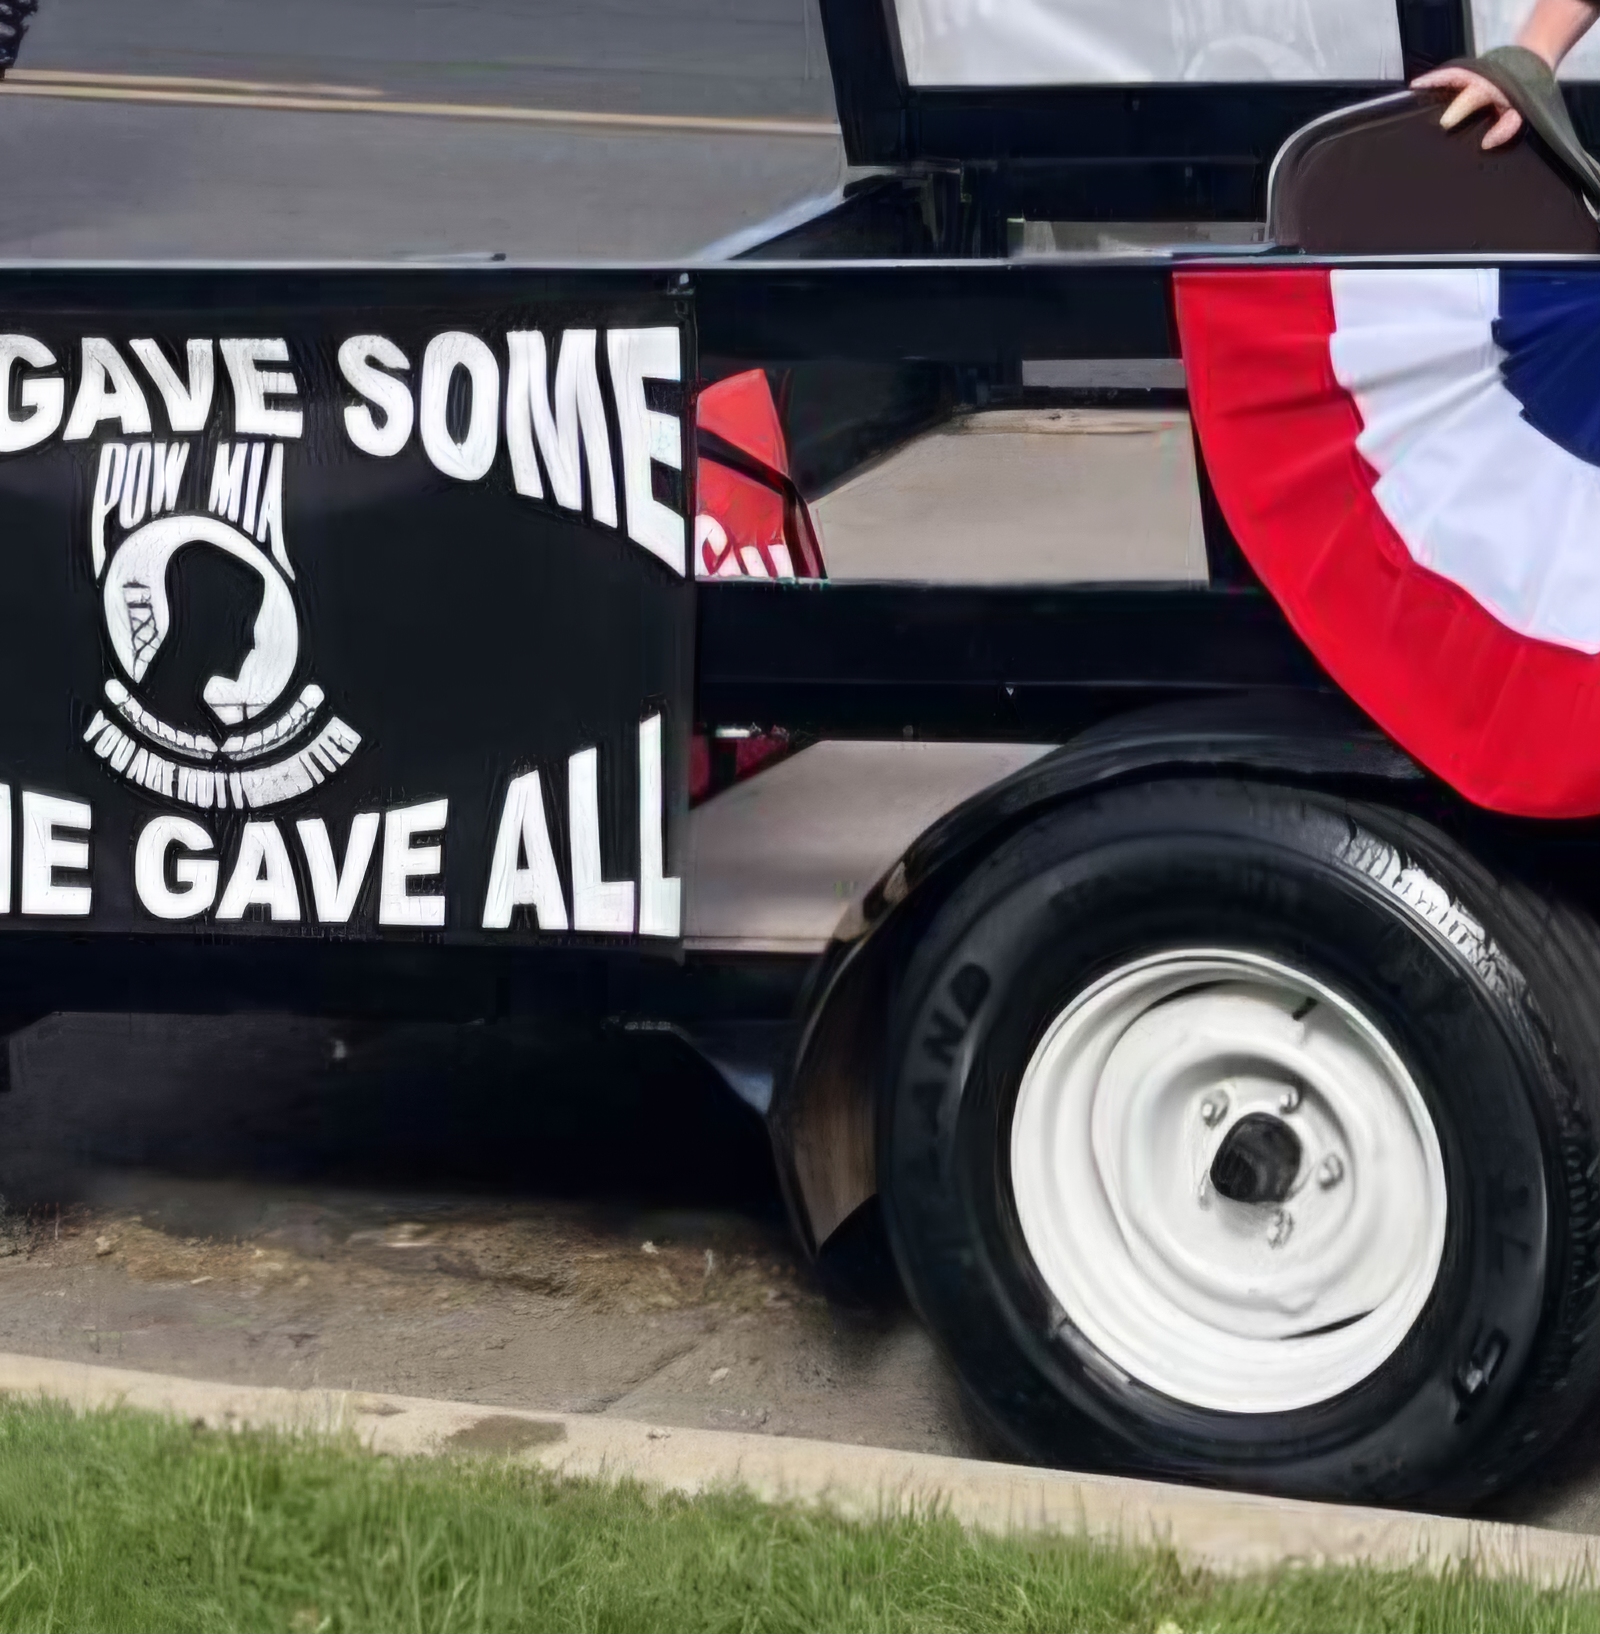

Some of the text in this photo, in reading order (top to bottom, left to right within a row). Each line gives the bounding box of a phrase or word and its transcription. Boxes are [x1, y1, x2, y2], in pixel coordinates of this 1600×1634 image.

[0, 326, 686, 580] GAVE SOME
[91, 442, 296, 581] POW MIA
[0, 782, 92, 916] E
[134, 798, 448, 927] GAVE
[483, 713, 681, 938] ALL
